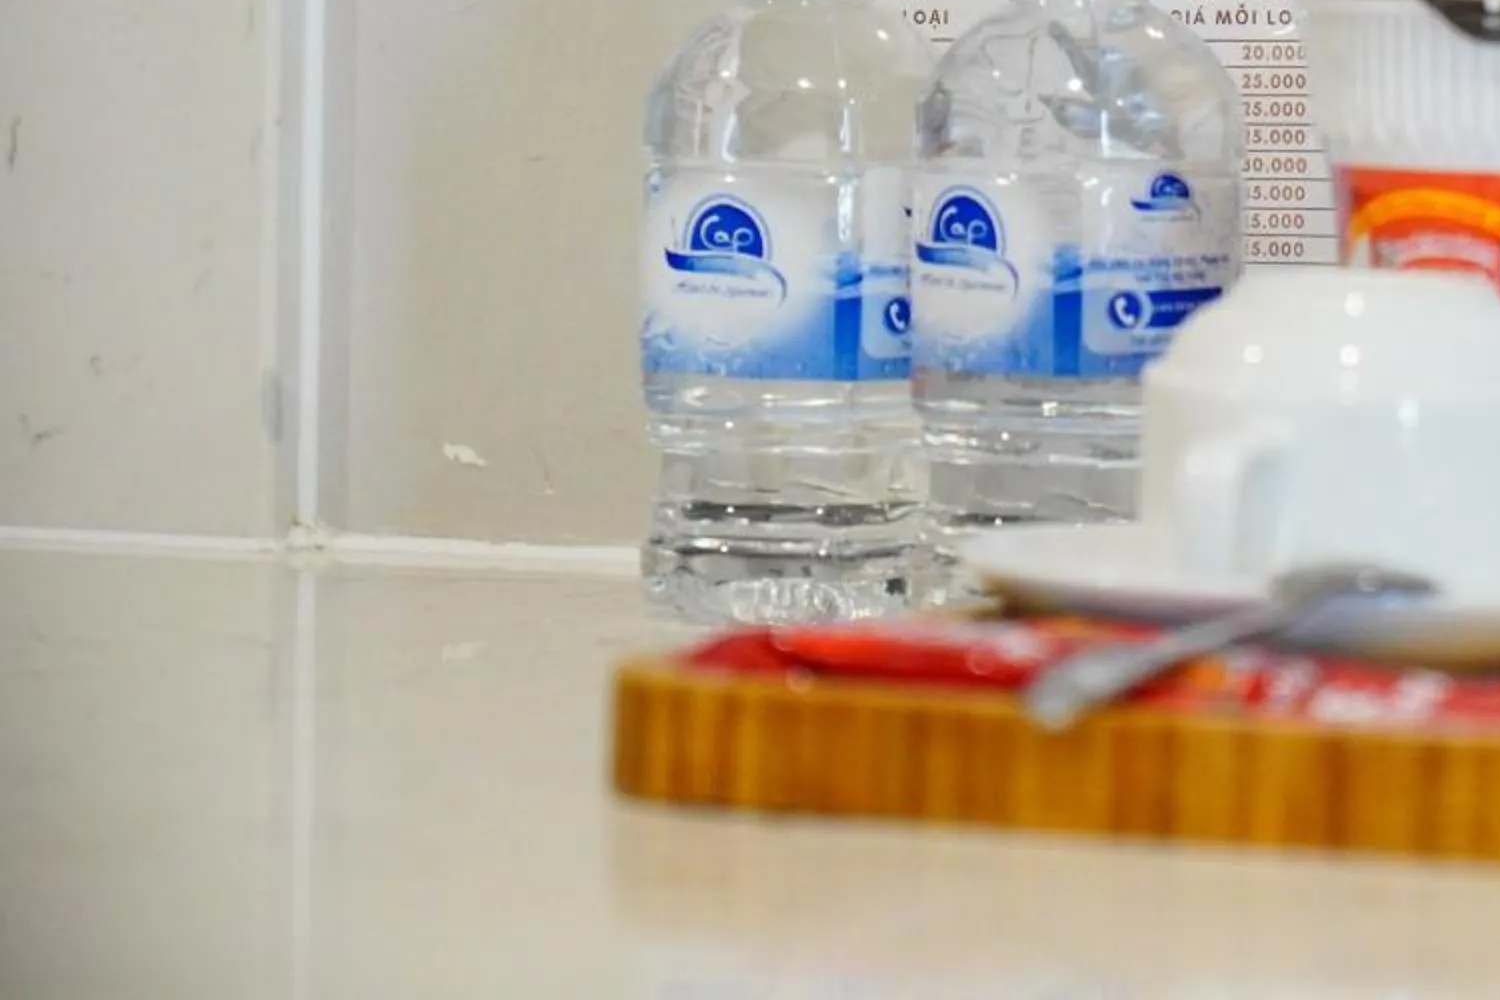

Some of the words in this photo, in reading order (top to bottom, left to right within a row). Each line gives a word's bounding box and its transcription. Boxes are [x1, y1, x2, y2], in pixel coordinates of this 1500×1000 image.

[1242, 73, 1307, 89] 25.000
[1246, 129, 1306, 145] 5.000
[1247, 184, 1306, 201] 5.000
[1246, 213, 1305, 229] 5.000
[1245, 241, 1304, 257] 5.000
